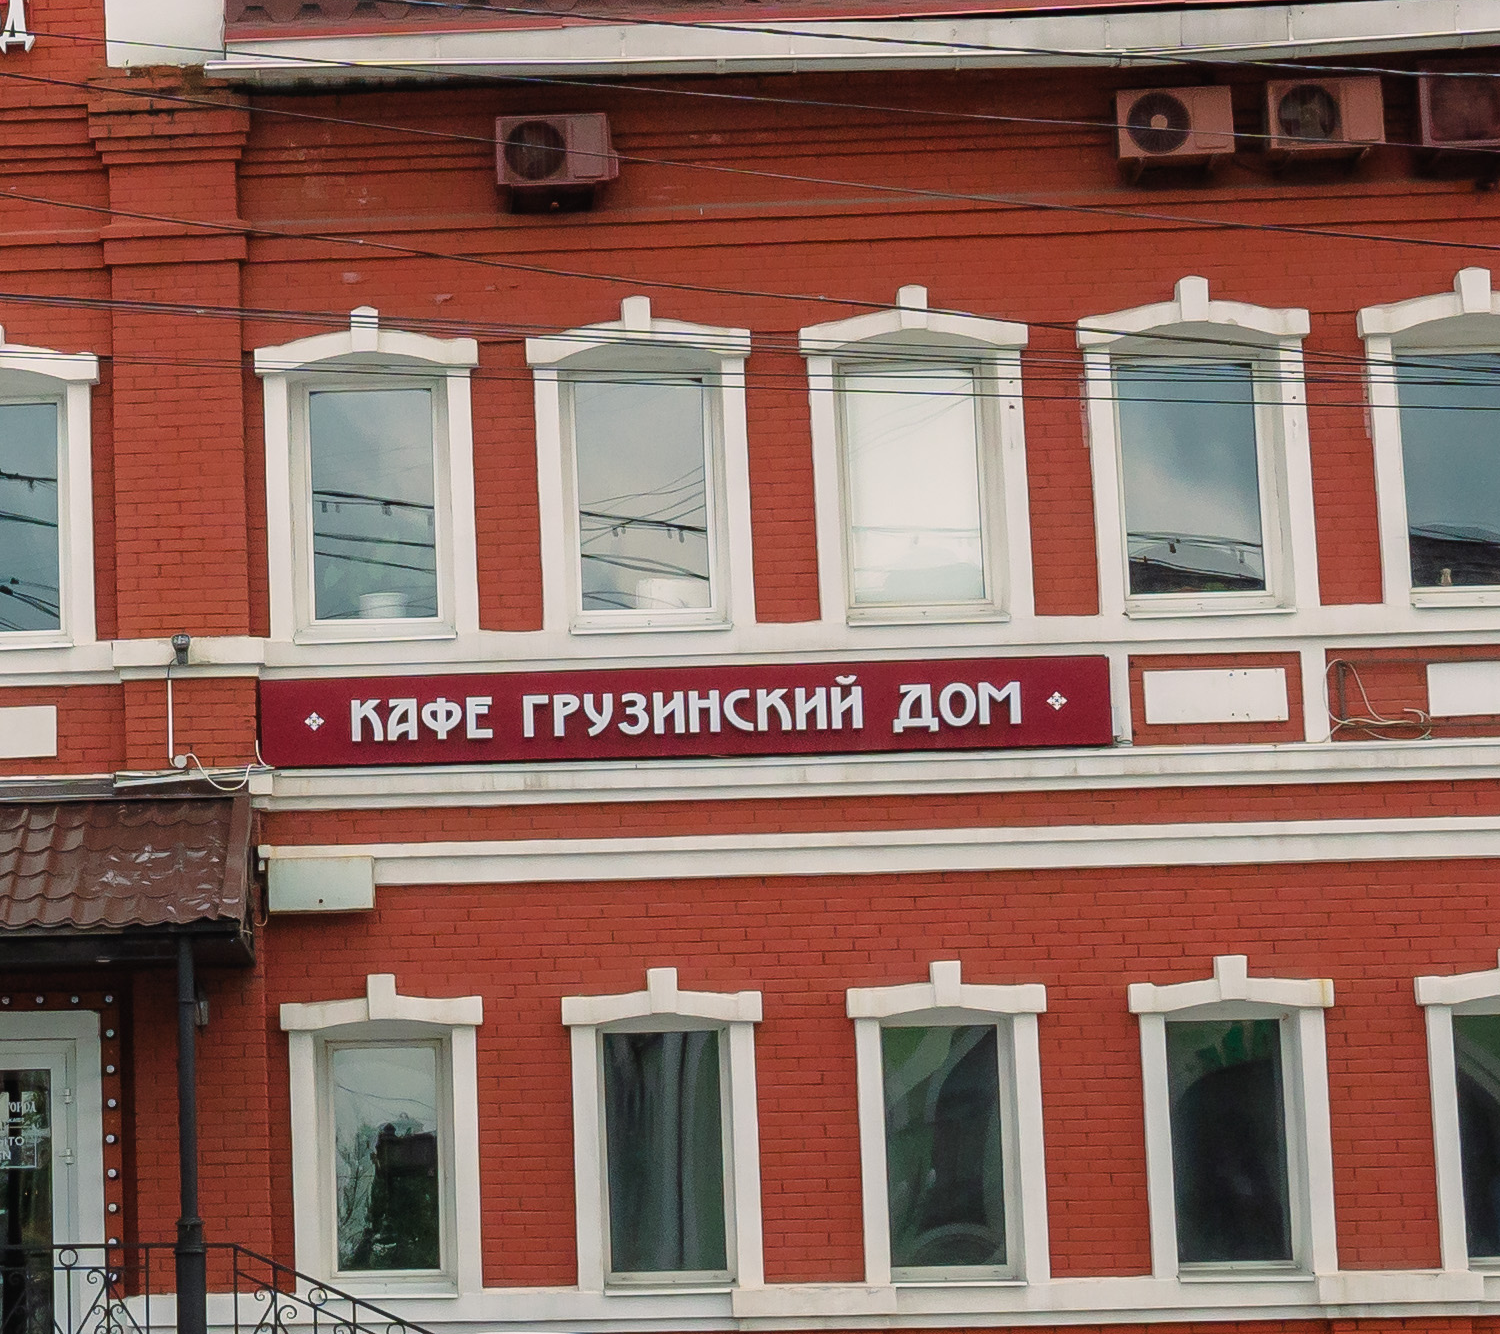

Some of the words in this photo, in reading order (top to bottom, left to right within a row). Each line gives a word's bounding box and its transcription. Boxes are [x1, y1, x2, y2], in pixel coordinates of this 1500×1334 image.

[350, 696, 494, 743] КАФЕ
[522, 675, 864, 739] ГРУЗИНСКИЙ
[893, 681, 1022, 733] ДОМ
